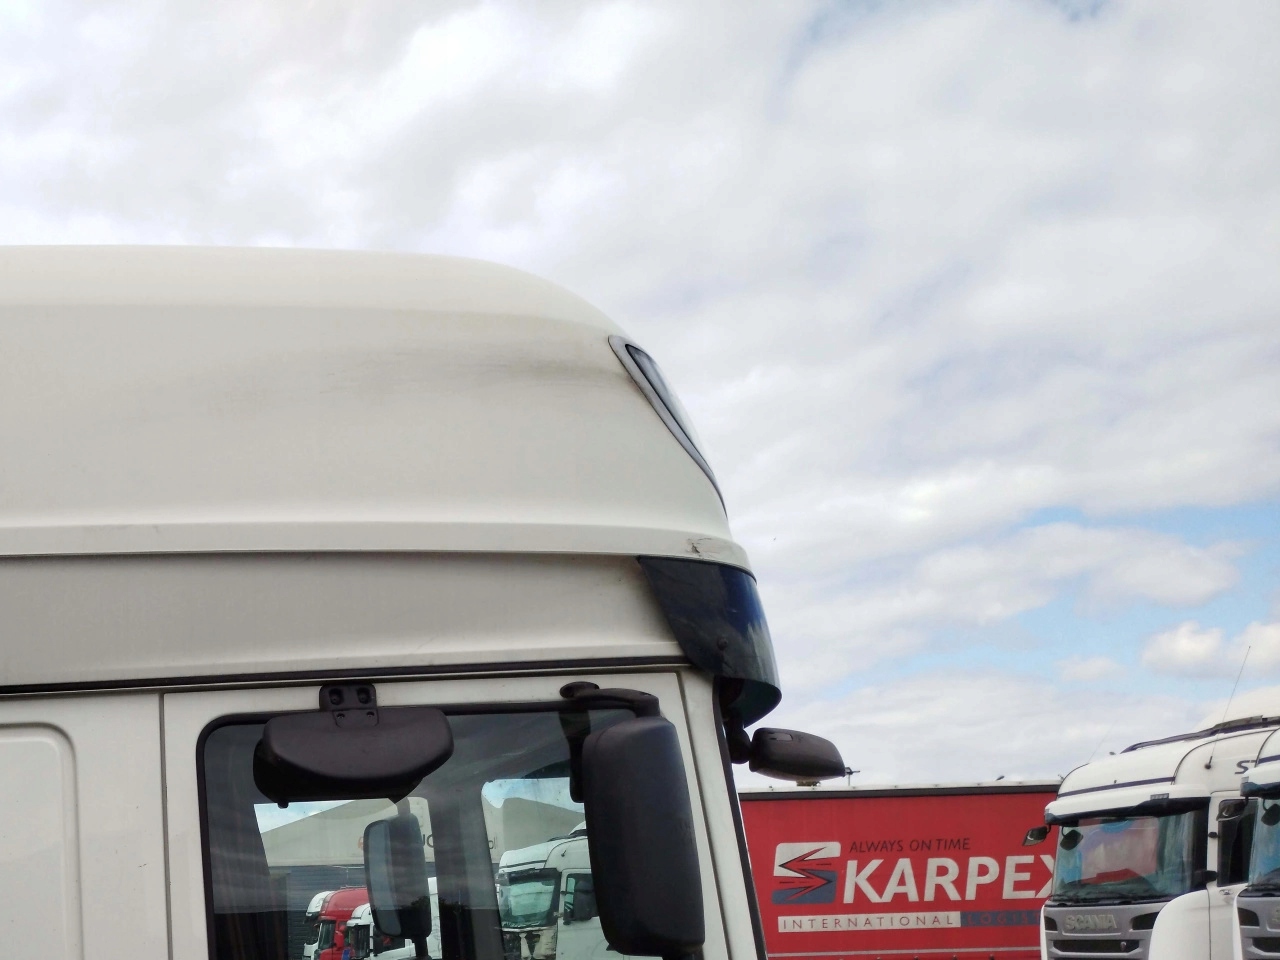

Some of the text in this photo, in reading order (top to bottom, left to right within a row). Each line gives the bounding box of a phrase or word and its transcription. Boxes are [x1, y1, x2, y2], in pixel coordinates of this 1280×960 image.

[849, 838, 971, 854] ALWAYS ON TIME
[782, 915, 954, 930] INTERNATIONAL
[1065, 913, 1118, 931] SCANIA
